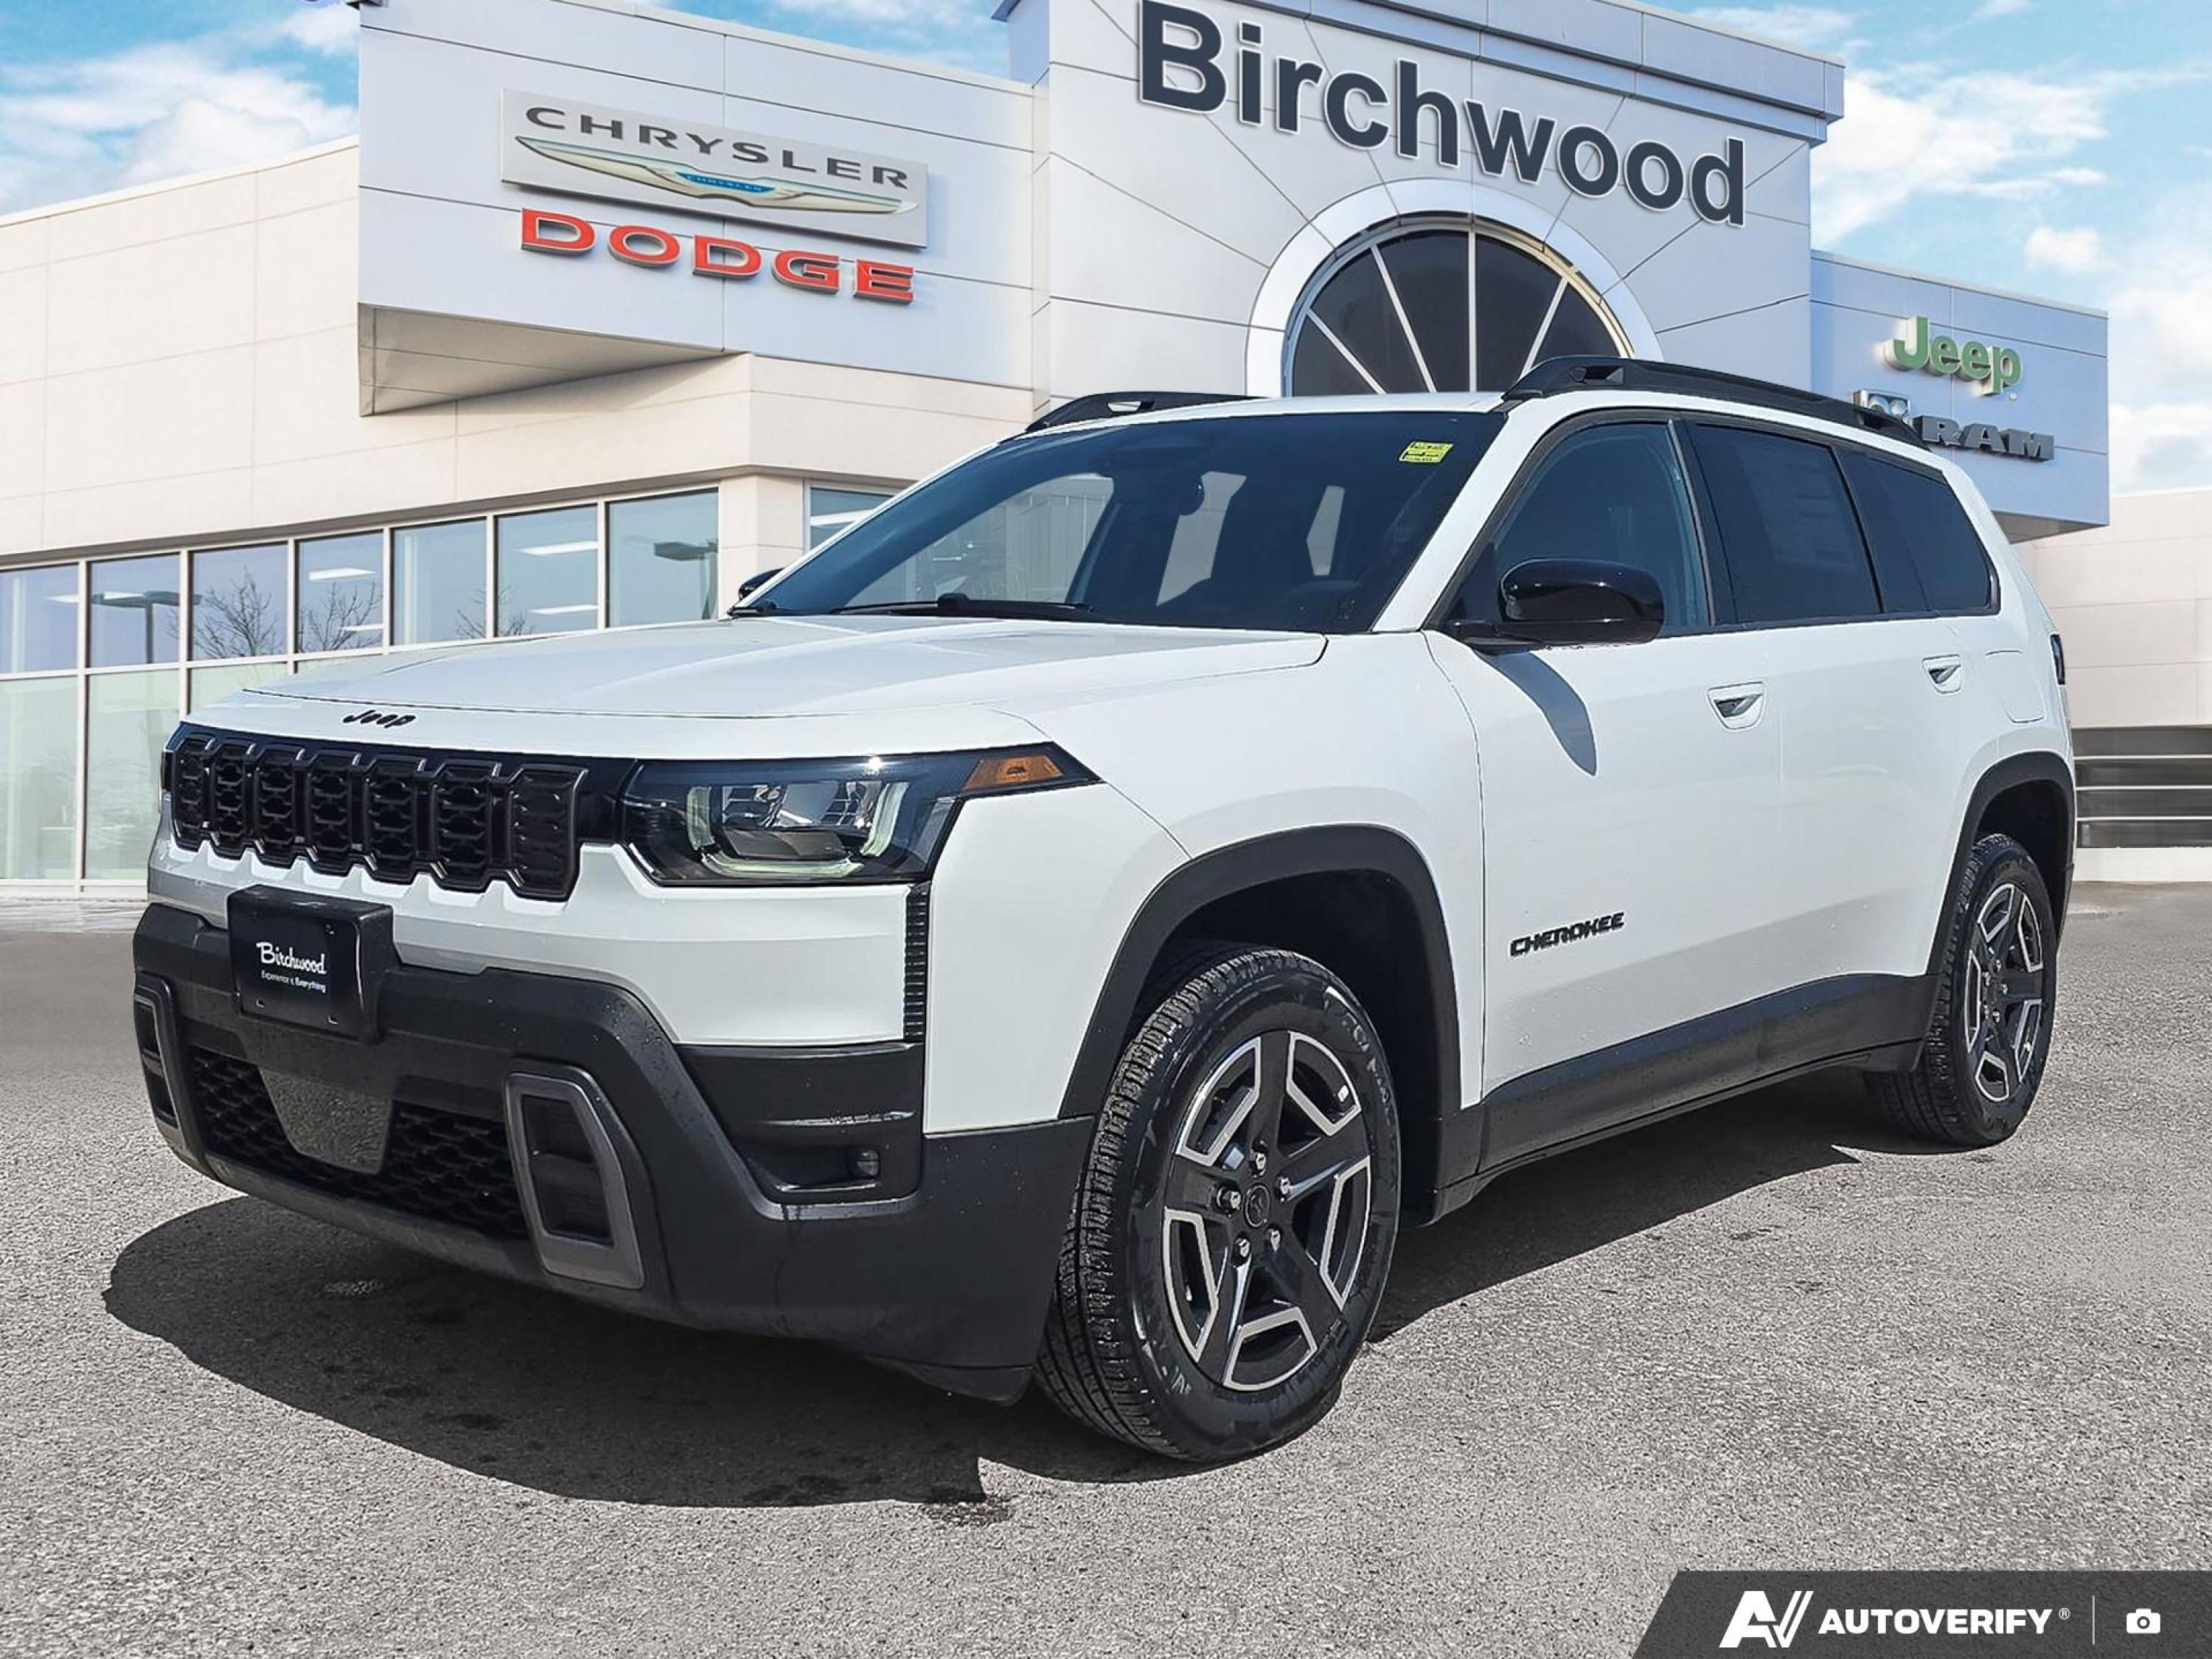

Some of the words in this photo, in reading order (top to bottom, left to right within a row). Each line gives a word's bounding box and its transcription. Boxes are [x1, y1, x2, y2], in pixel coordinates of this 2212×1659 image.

[1139, 0, 1746, 227] Birchwood
[526, 107, 908, 189] CHRYSLER
[521, 208, 915, 305] DODGE
[1885, 315, 2023, 395] Jeep
[1914, 415, 2055, 462] RAM
[343, 709, 417, 728] Jeep
[256, 942, 327, 975] Birchwood
[1510, 912, 1625, 956] CHEROKEE
